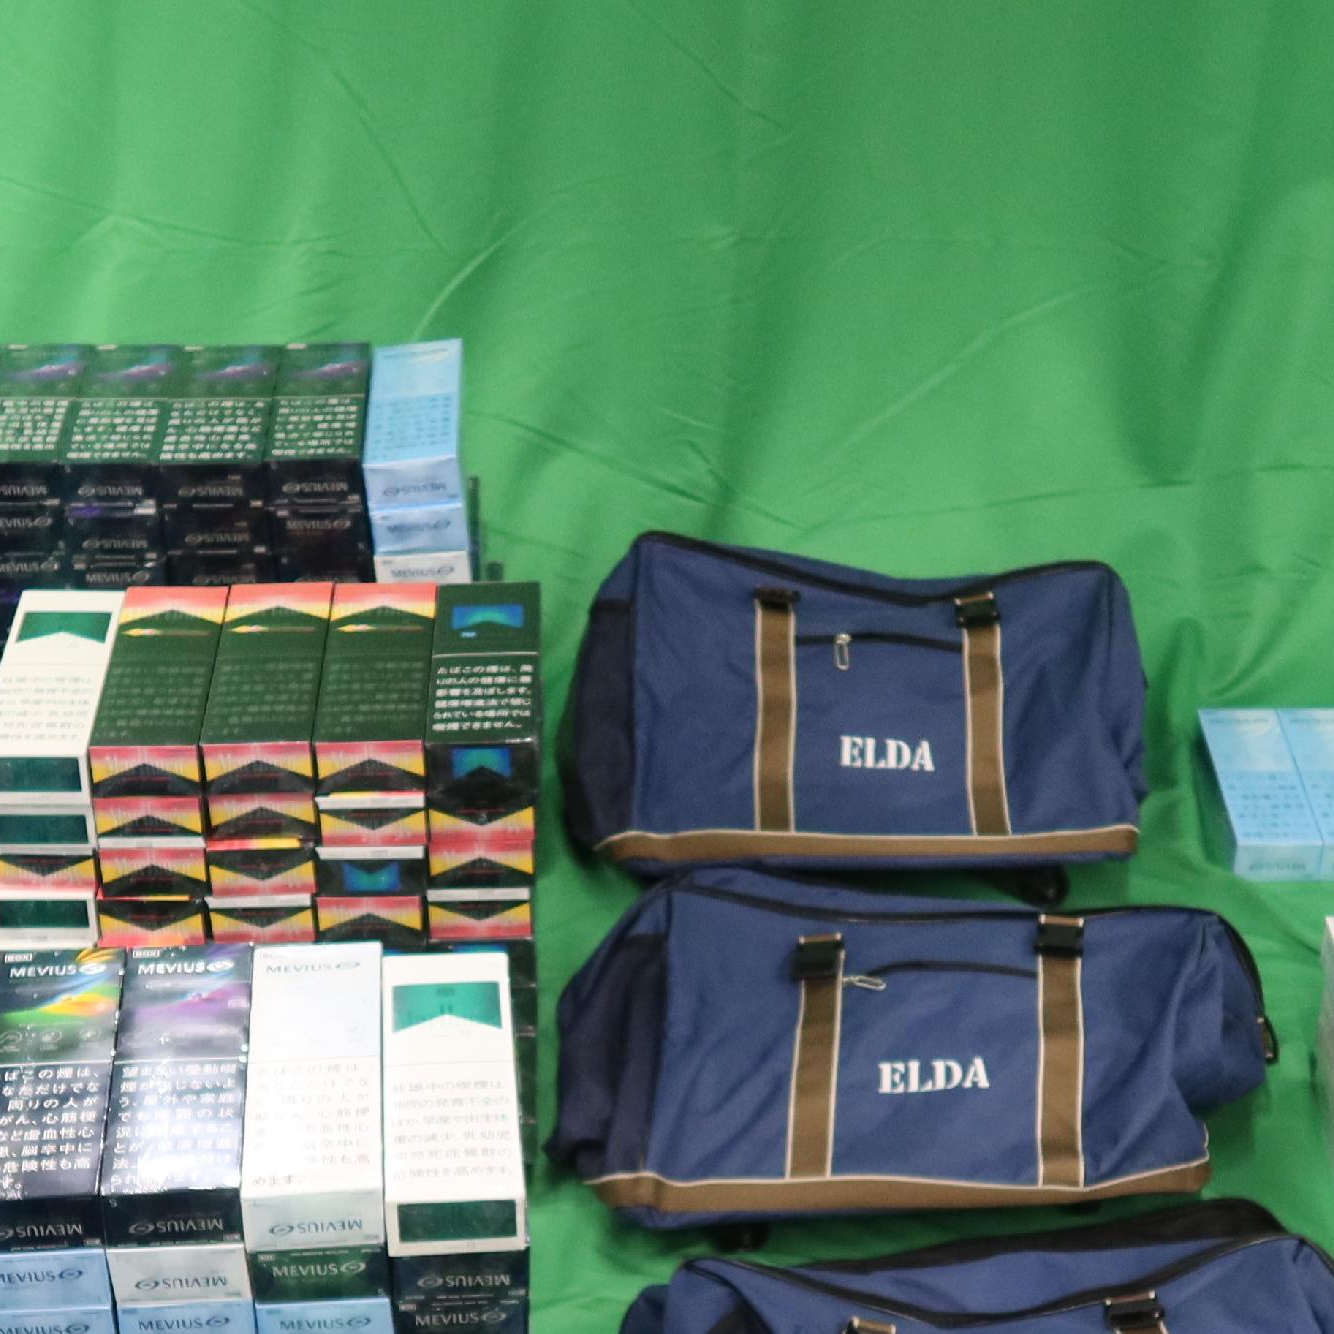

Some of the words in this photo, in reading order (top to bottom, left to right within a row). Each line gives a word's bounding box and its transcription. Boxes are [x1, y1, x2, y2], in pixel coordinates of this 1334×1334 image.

[839, 736, 935, 772] ELDA
[10, 965, 77, 978] MEVIUS
[138, 962, 205, 975] MEVIUS
[266, 962, 335, 973] MEVIUS
[878, 1057, 990, 1095] ELDA
[18, 1224, 83, 1238] MEVIUS
[156, 1218, 224, 1233] MEVIUS
[300, 1219, 362, 1234] MEVIUS
[272, 1262, 338, 1278] MEVIUS
[139, 1317, 204, 1330] MEVIUS
[415, 1312, 479, 1325] MEVIUS
